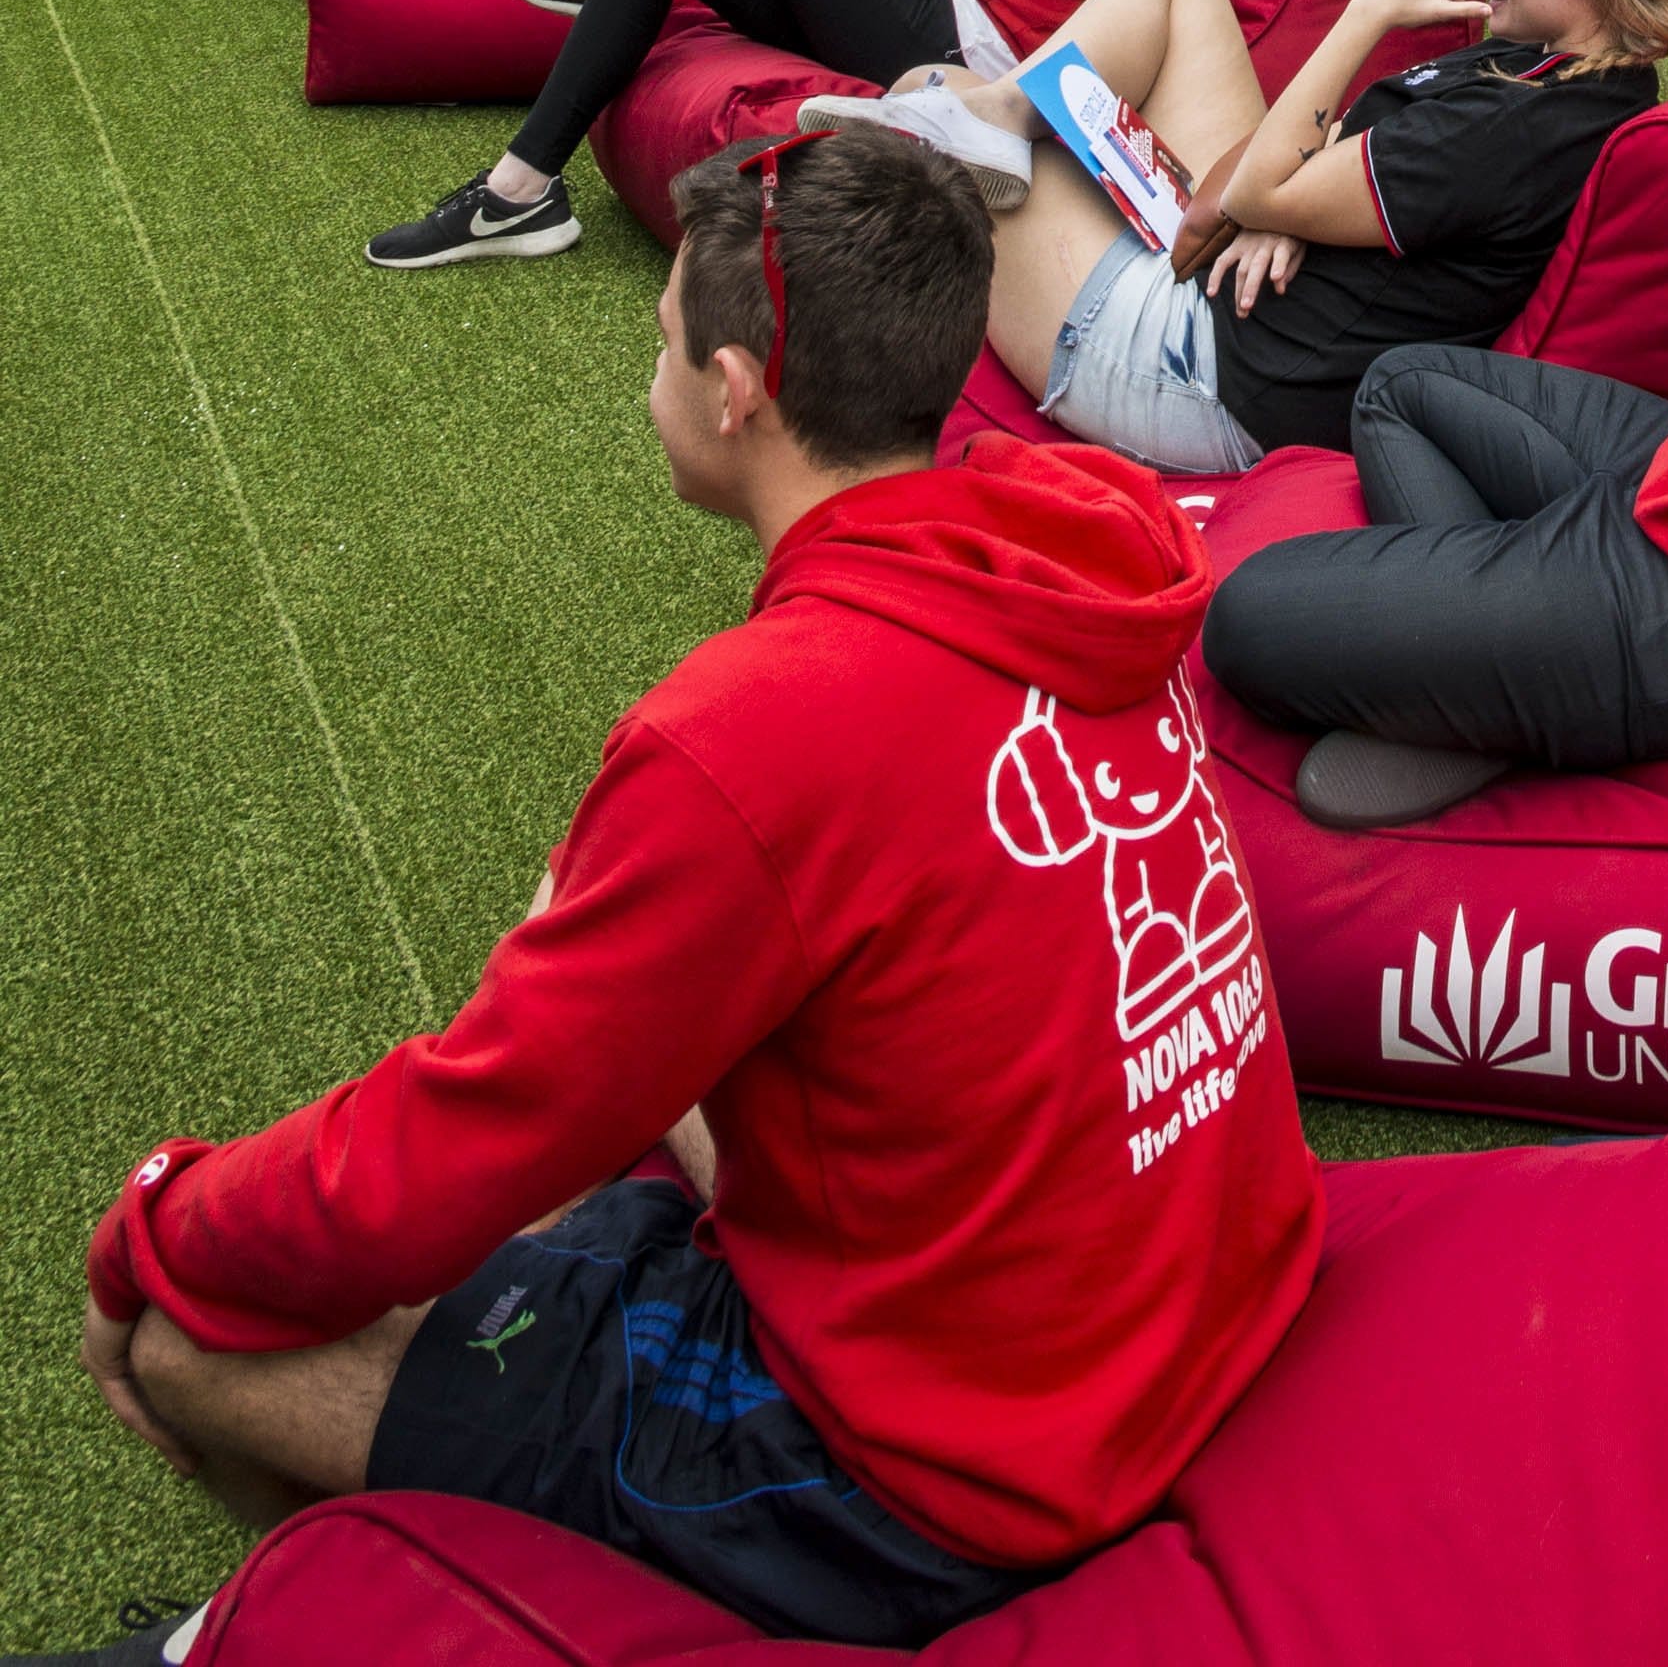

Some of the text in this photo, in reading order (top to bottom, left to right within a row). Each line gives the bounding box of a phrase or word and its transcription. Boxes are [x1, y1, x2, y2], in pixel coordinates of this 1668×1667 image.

[1123, 1005, 1218, 1113] NOVA
[1127, 1127, 1182, 1176] live
[1181, 1067, 1236, 1129] life
